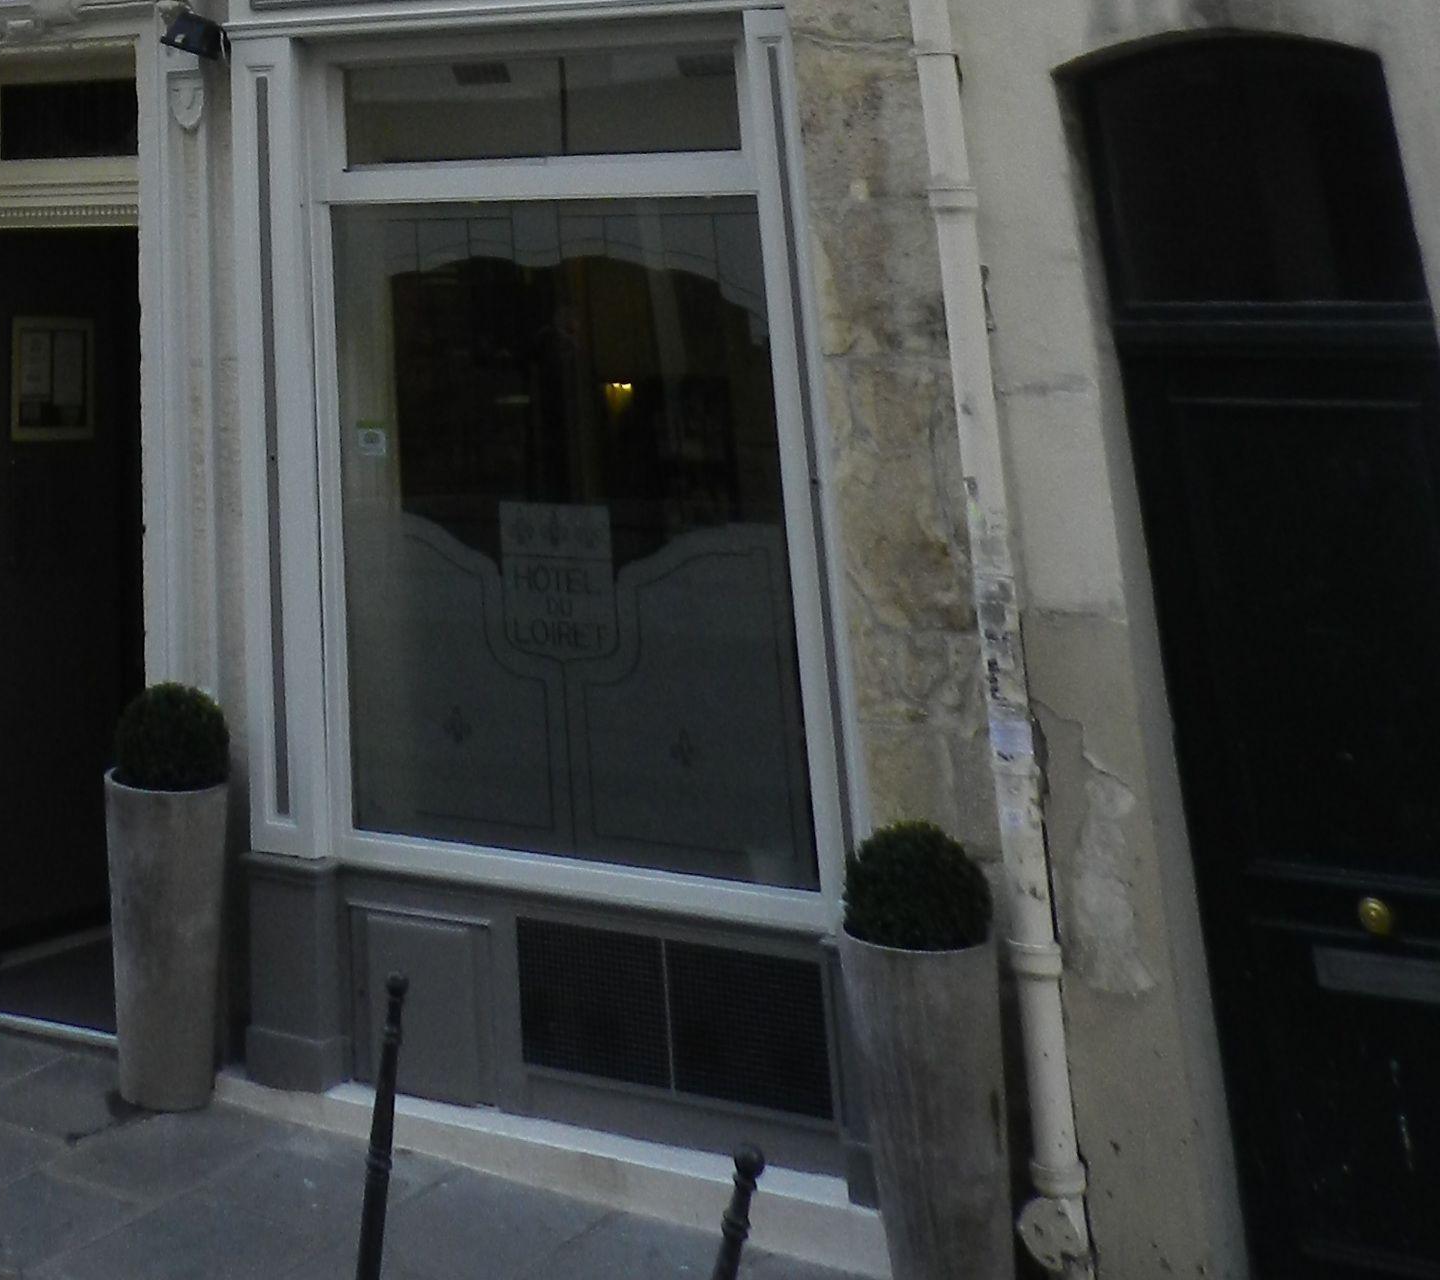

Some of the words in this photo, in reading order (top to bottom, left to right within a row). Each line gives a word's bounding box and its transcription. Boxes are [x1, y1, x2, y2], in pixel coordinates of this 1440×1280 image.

[514, 564, 600, 595] HOTEL
[546, 596, 573, 617] DU
[513, 618, 606, 649] LOIRET
